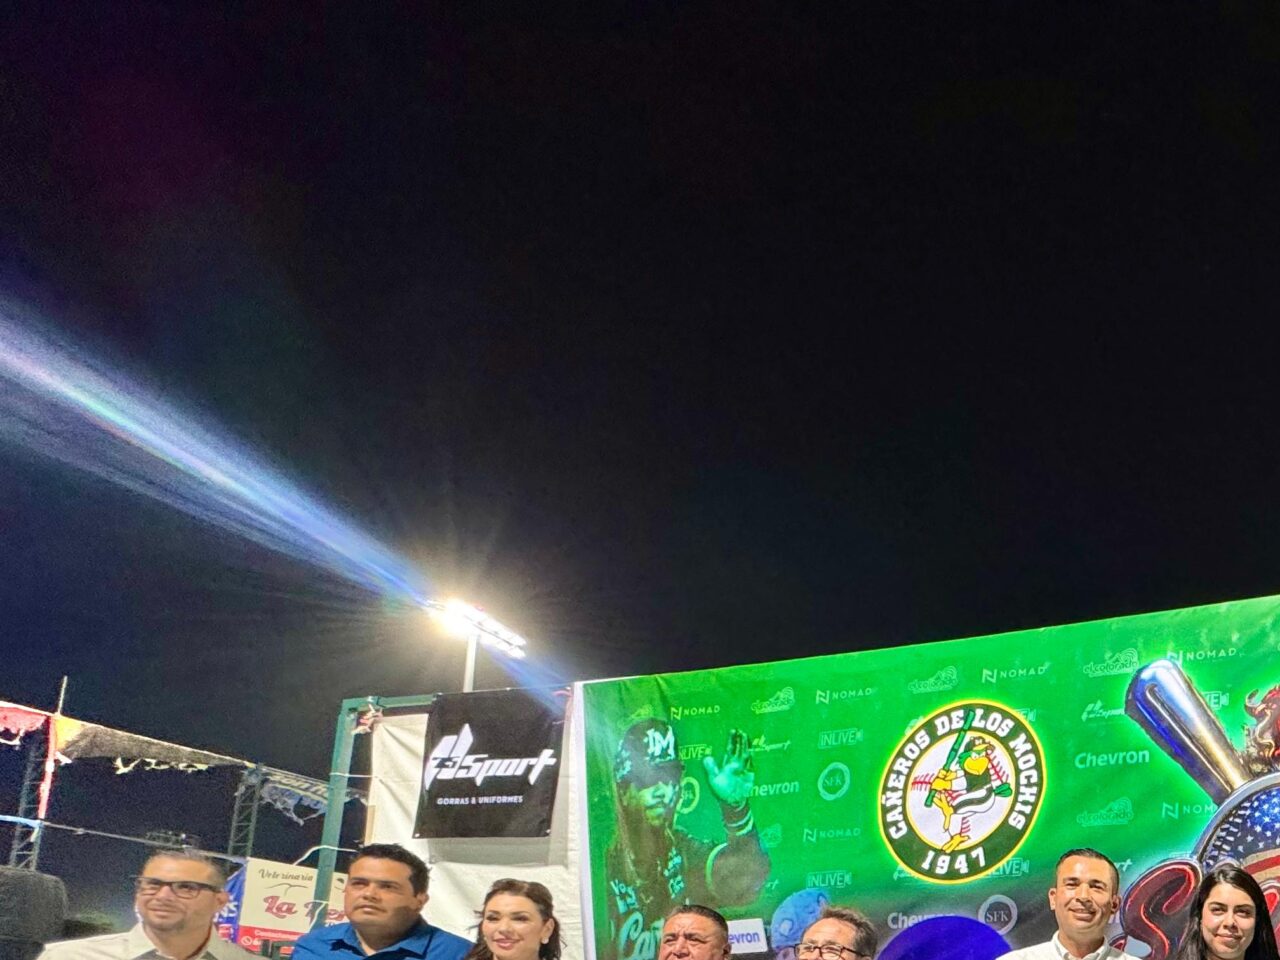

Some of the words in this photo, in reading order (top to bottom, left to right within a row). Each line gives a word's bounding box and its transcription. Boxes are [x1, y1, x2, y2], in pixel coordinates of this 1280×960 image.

[1186, 648, 1237, 661] NOMAD
[1000, 667, 1046, 679] NOMAD
[832, 688, 872, 699] NOMAD
[683, 705, 720, 715] NOMAD
[820, 730, 856, 746] INLIVE
[1074, 750, 1150, 769] Chevron
[881, 730, 931, 839] CAÑEROS
[934, 710, 964, 735] DE
[972, 709, 1015, 737] LOS
[1009, 733, 1039, 831] MOCHIS
[750, 781, 800, 798] hevron
[437, 798, 469, 806] GORRAS
[478, 796, 523, 804] UNIFORMES
[1183, 804, 1214, 814] NOM
[819, 828, 861, 838] NOMAD
[921, 847, 986, 875] 1947
[807, 871, 846, 888] INLIVE
[263, 895, 298, 919] La
[986, 911, 1010, 923] SFK
[729, 931, 760, 946] evron
